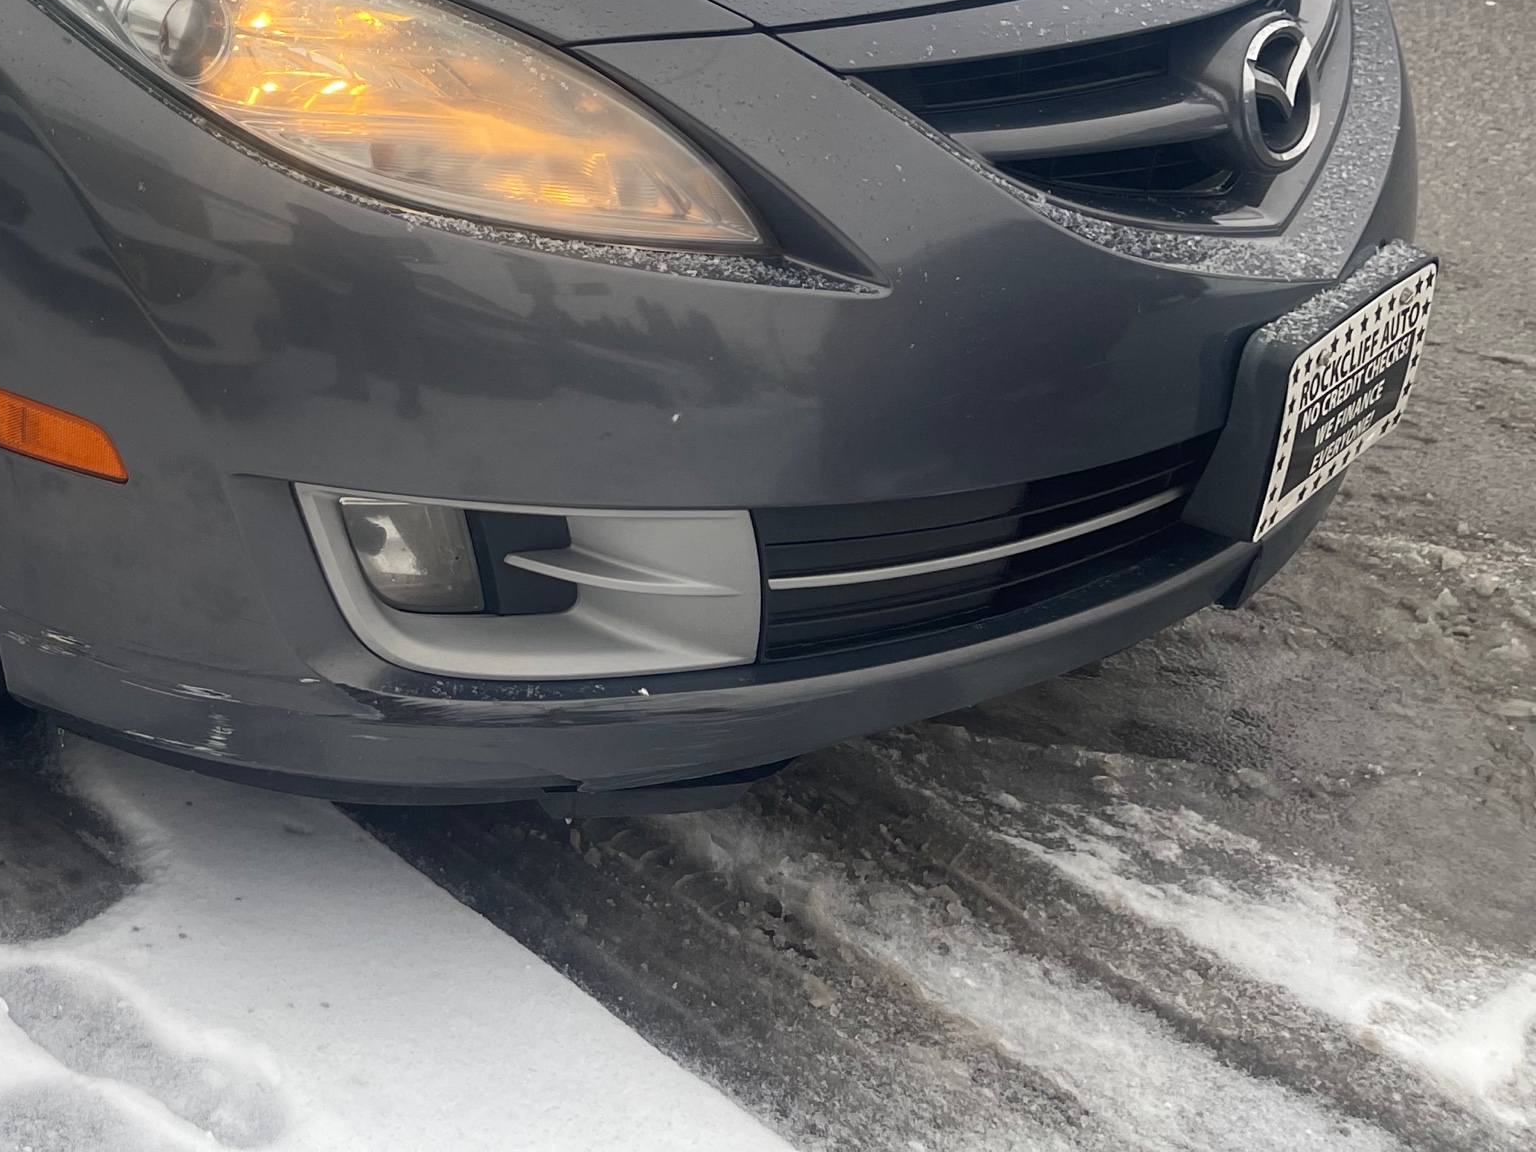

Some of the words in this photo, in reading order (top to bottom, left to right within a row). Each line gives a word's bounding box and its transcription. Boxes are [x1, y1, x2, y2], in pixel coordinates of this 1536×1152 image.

[1301, 331, 1378, 408] ROCKCLIFF
[1381, 301, 1420, 350] AUTO
[1302, 403, 1320, 433] NO
[1321, 370, 1365, 415] CREDIT
[1365, 335, 1411, 384] CHECKS!
[1309, 410, 1375, 474] EVERYONE!
[1315, 419, 1335, 447] WE
[1335, 379, 1385, 434] FINANCE
